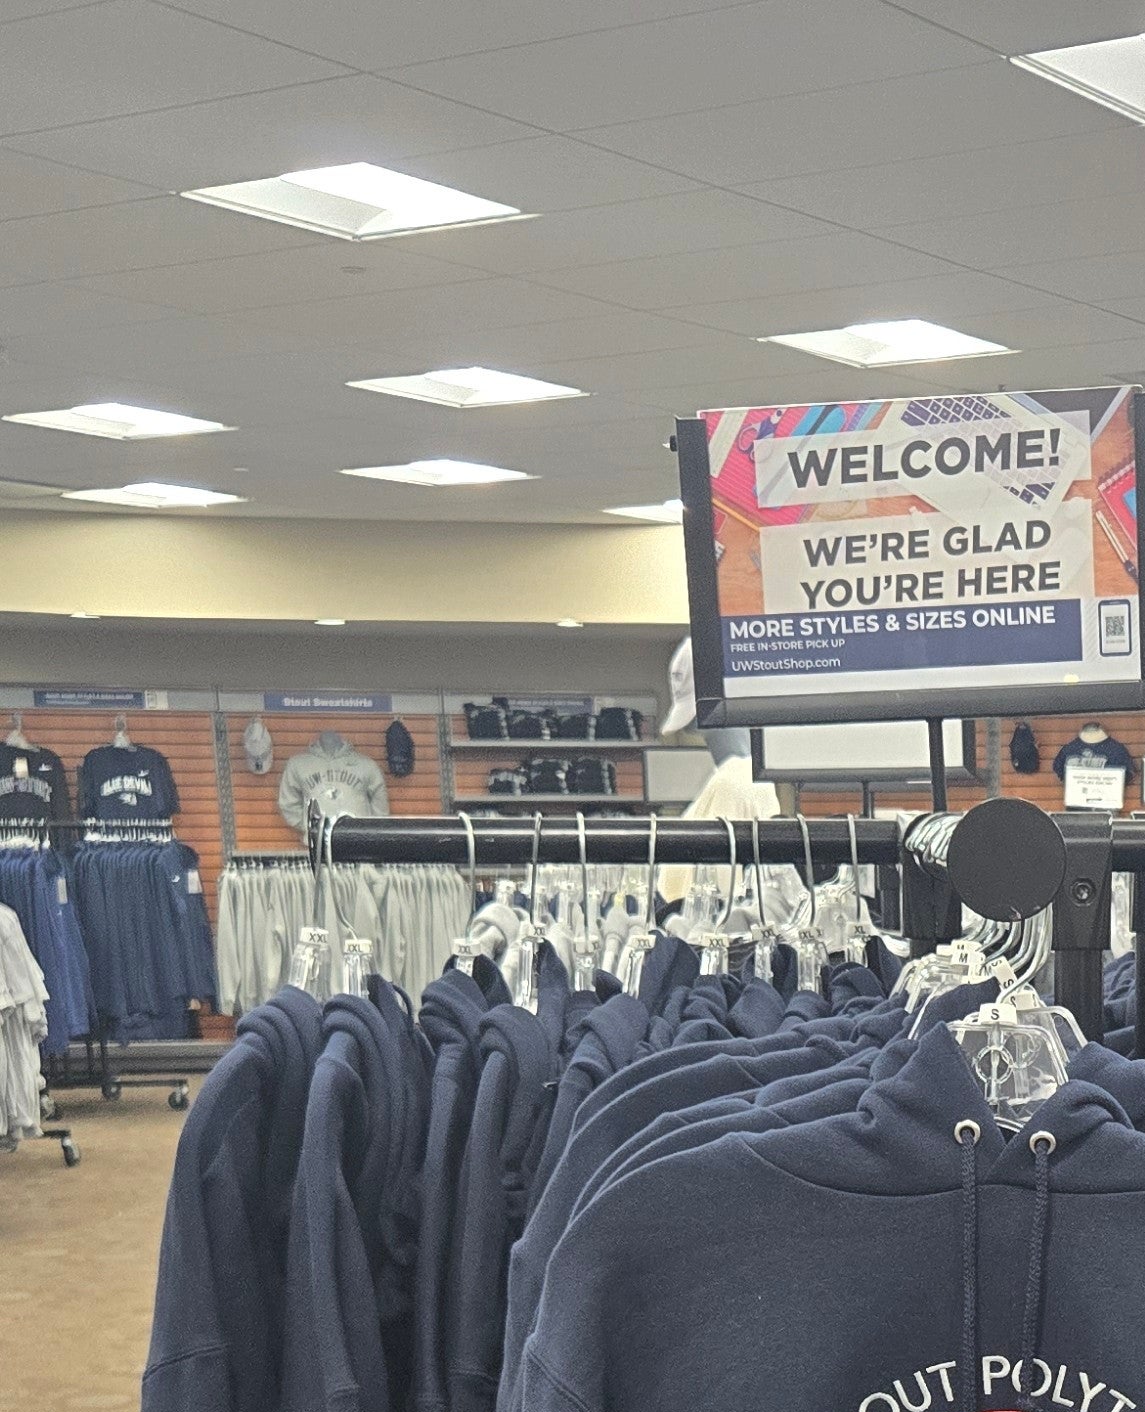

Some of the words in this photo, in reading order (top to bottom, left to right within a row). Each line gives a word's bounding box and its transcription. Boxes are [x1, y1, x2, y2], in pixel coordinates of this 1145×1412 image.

[787, 428, 1062, 489] WELCOME!
[803, 529, 930, 568] WE'RE
[943, 519, 1052, 557] GLAD
[800, 570, 945, 610] YOU'RE
[957, 561, 1061, 599] HERE
[730, 618, 794, 640] MORE
[799, 614, 878, 636] STYLES
[884, 615, 900, 632] &
[905, 610, 966, 631] SIZES
[973, 605, 1056, 628] ONLINE
[730, 643, 755, 653] FREE
[757, 640, 803, 652] IN-STORE
[806, 639, 829, 649] PICK
[831, 638, 845, 649] UP
[731, 656, 841, 672] UWStoutShop.com
[709, 938, 725, 948] XXL
[959, 953, 968, 963] M
[991, 1009, 1000, 1020] S
